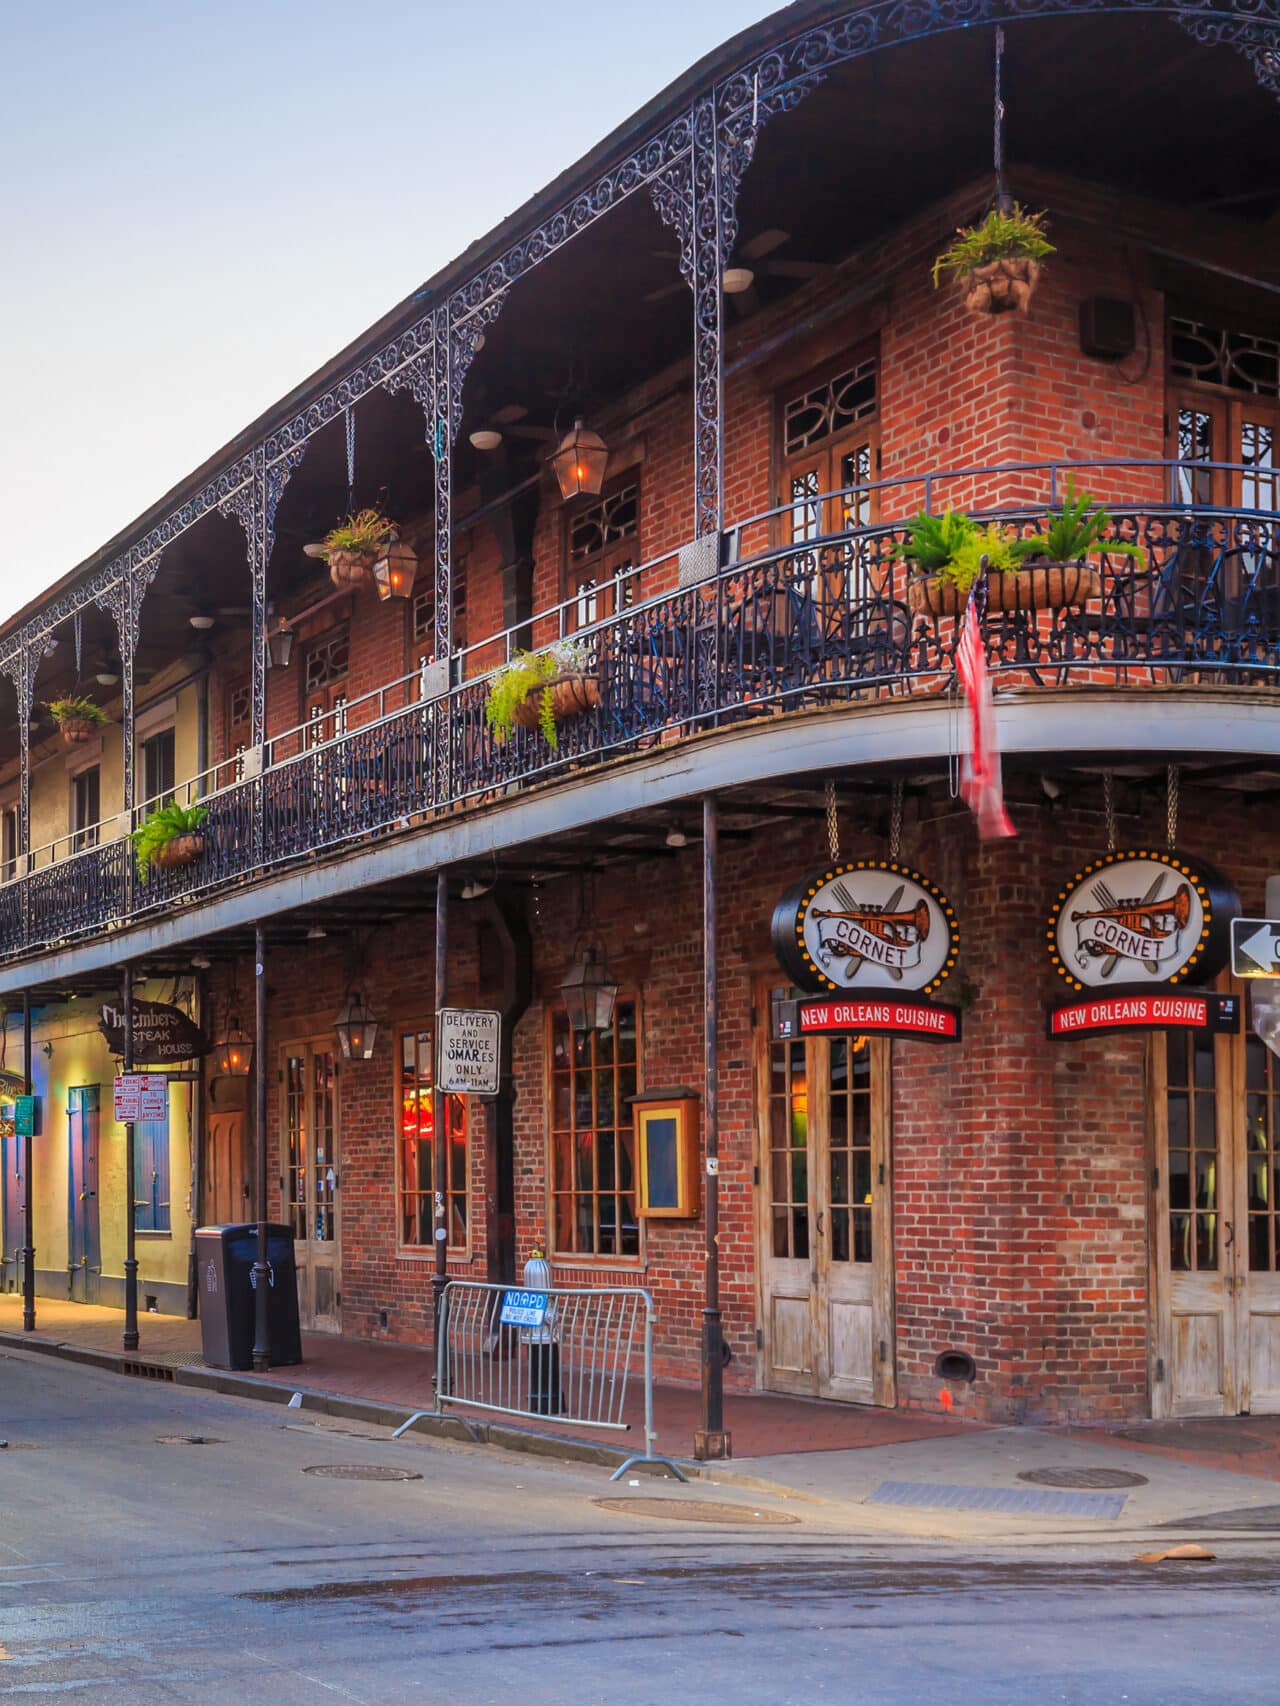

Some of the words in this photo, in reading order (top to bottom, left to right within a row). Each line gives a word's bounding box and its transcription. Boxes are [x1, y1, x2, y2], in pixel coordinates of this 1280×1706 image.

[836, 921, 907, 966] CORNET
[1094, 920, 1164, 958] CORNET
[132, 1006, 178, 1028] Embers
[446, 1015, 494, 1028] DELIVERY
[801, 1008, 828, 1026] NEW
[834, 1006, 890, 1023] ORLEANS
[895, 1007, 946, 1030] CUISINE
[1060, 1008, 1086, 1029] NEW
[1091, 1002, 1147, 1022] ORLEANS
[1153, 1001, 1205, 1020] CUISINE
[132, 1030, 170, 1042] STEAK
[462, 1029, 478, 1037] AND
[158, 1043, 193, 1055] HOUSE
[449, 1038, 490, 1050] SERVICE
[456, 1064, 482, 1075] ONLY
